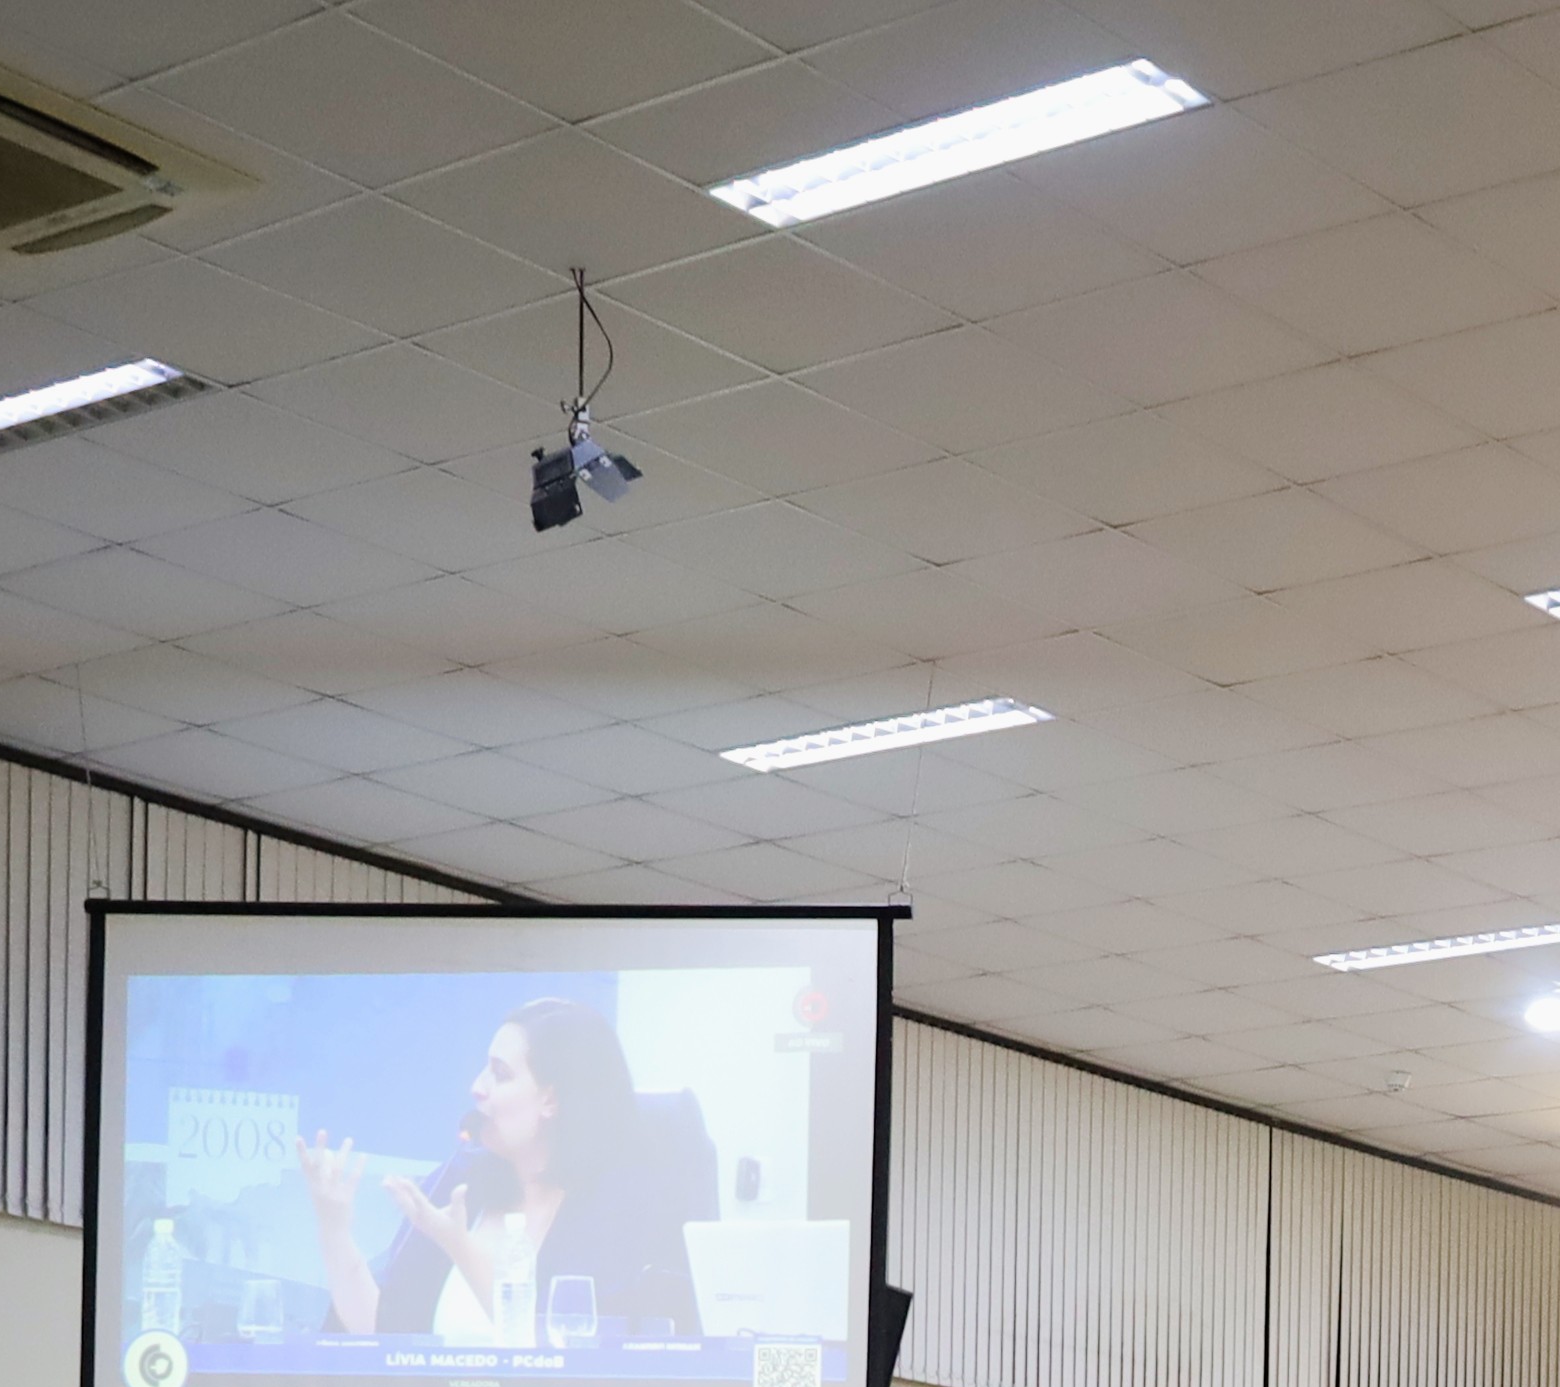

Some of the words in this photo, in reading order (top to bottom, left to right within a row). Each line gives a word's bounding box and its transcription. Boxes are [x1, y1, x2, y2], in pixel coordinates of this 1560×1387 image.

[178, 1114, 286, 1162] 2008
[386, 1351, 426, 1367] LÍVIA
[430, 1354, 498, 1368] MACEDO
